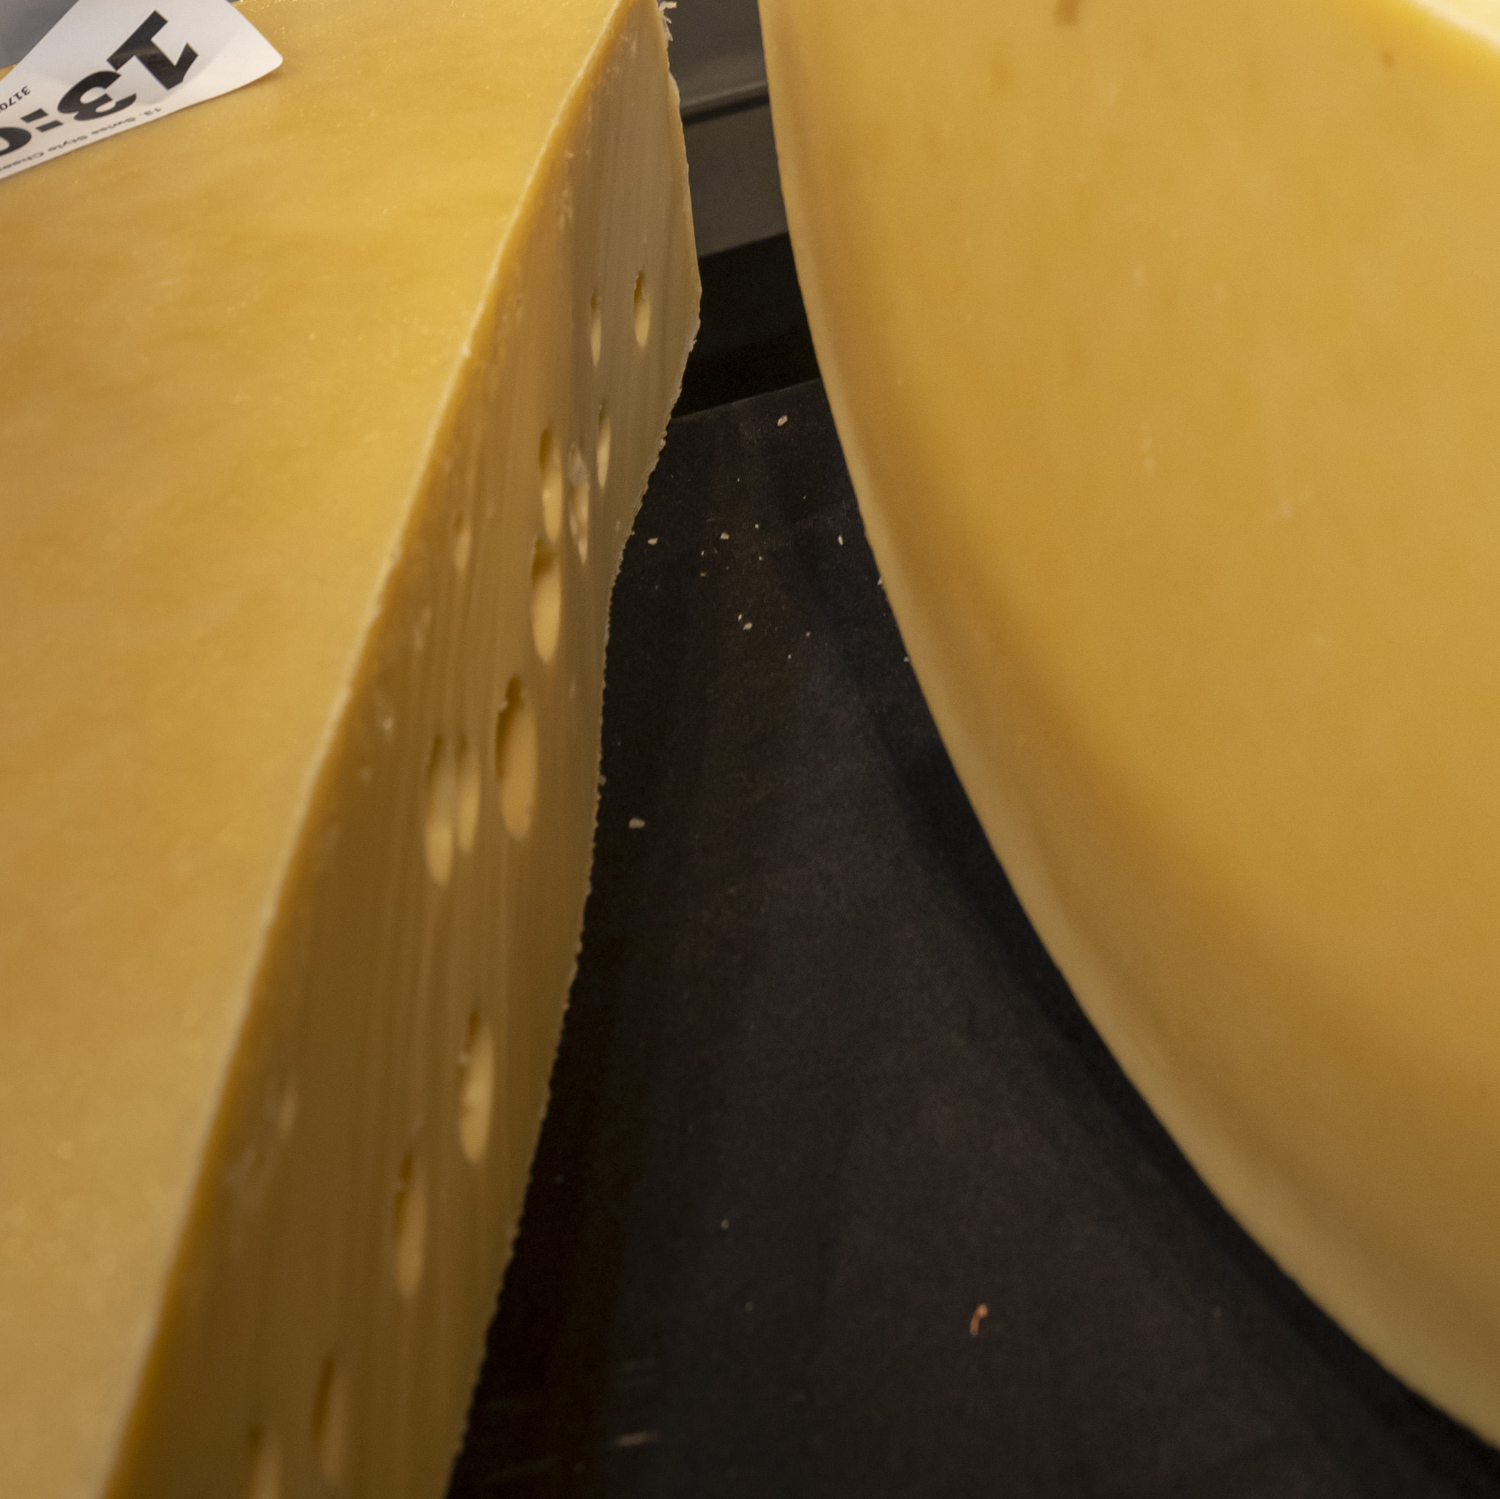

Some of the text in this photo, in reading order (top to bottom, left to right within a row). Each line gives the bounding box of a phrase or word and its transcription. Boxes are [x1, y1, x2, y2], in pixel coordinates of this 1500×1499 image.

[0, 86, 31, 114] 3170
[91, 116, 137, 135] Swiss
[47, 134, 89, 152] Style
[0, 151, 45, 171] Chee
